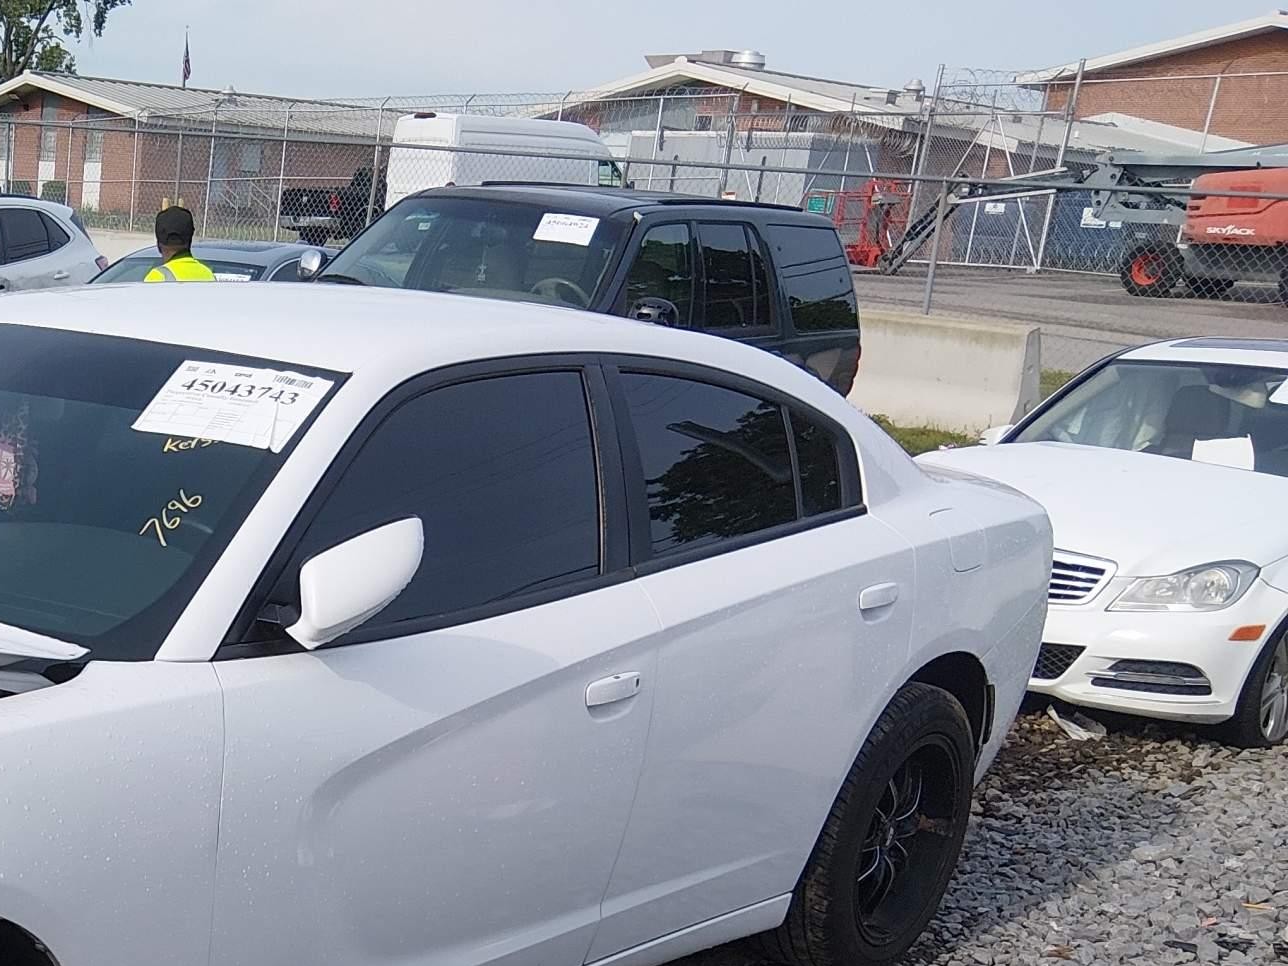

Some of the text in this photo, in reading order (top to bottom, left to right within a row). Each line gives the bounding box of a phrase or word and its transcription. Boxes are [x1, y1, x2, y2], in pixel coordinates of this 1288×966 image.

[1206, 224, 1256, 236] SKYJACK
[181, 377, 300, 406] 45043743
[139, 488, 202, 547] 7696
